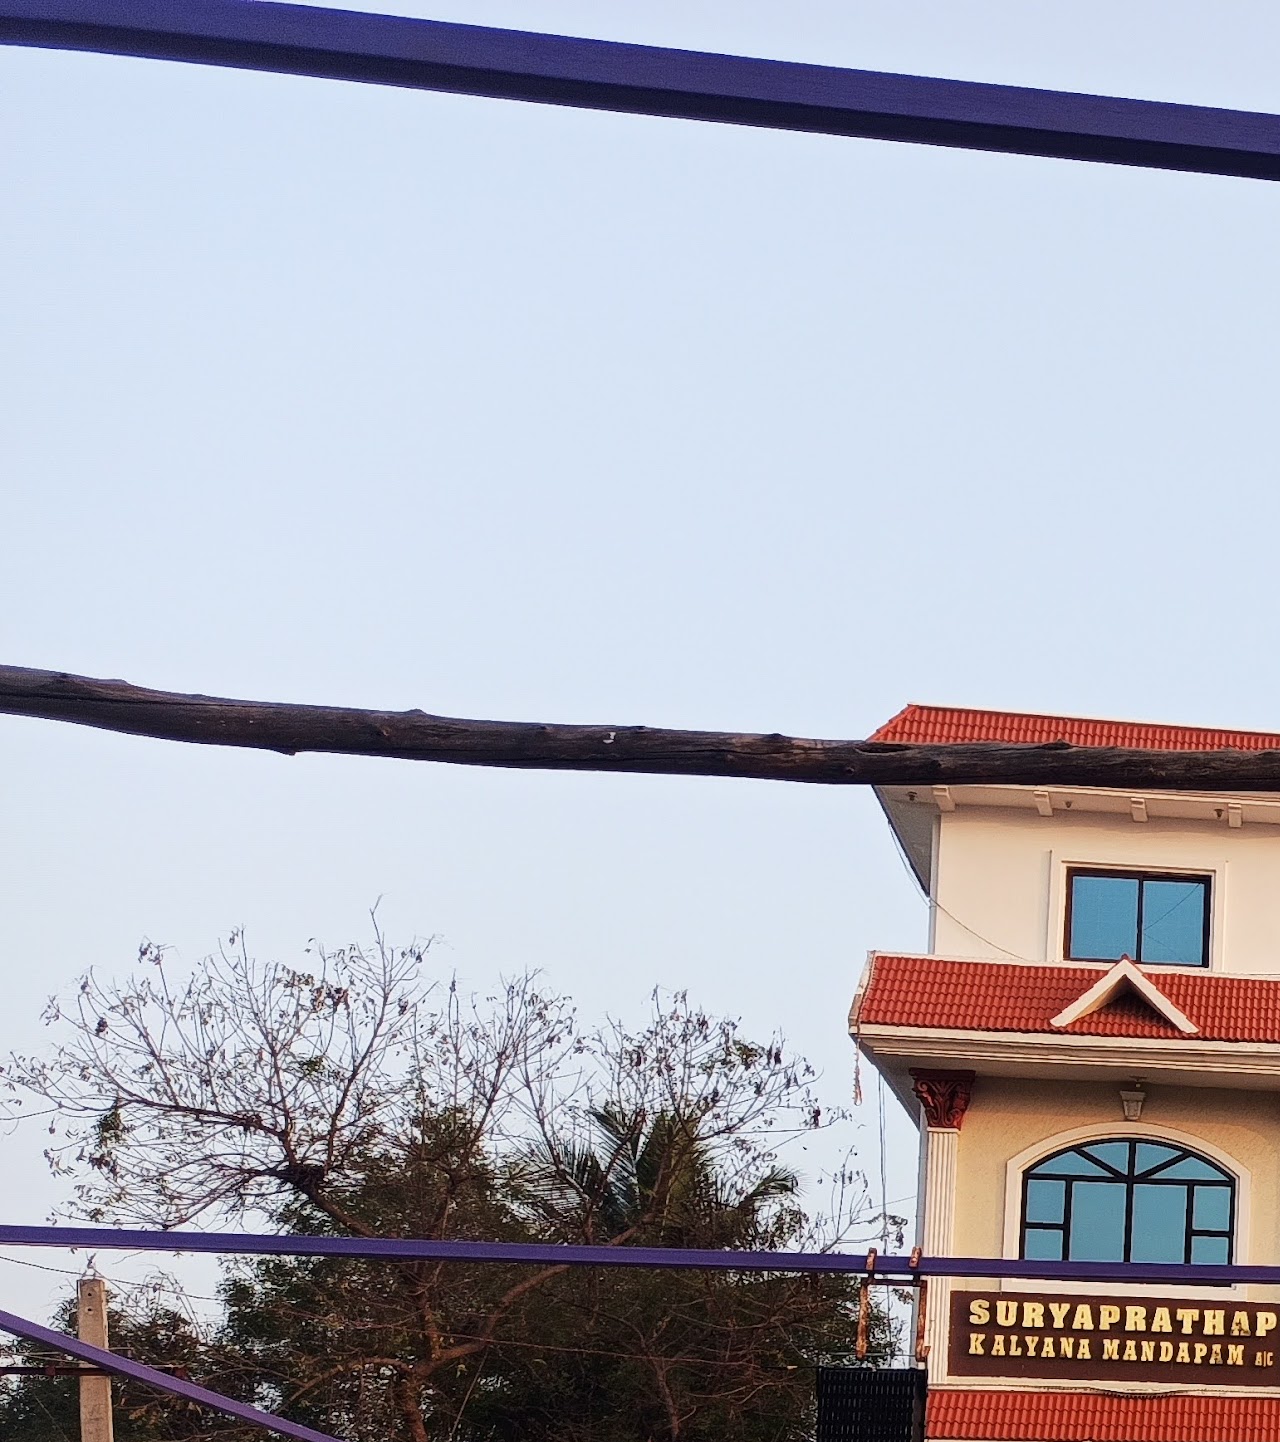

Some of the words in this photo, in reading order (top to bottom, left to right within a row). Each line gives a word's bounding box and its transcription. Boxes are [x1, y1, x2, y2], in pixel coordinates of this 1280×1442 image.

[968, 1298, 1278, 1337] SURYAPRATHAP
[968, 1332, 1092, 1359] KALYANA
[1101, 1337, 1246, 1366] MANDAPAM
